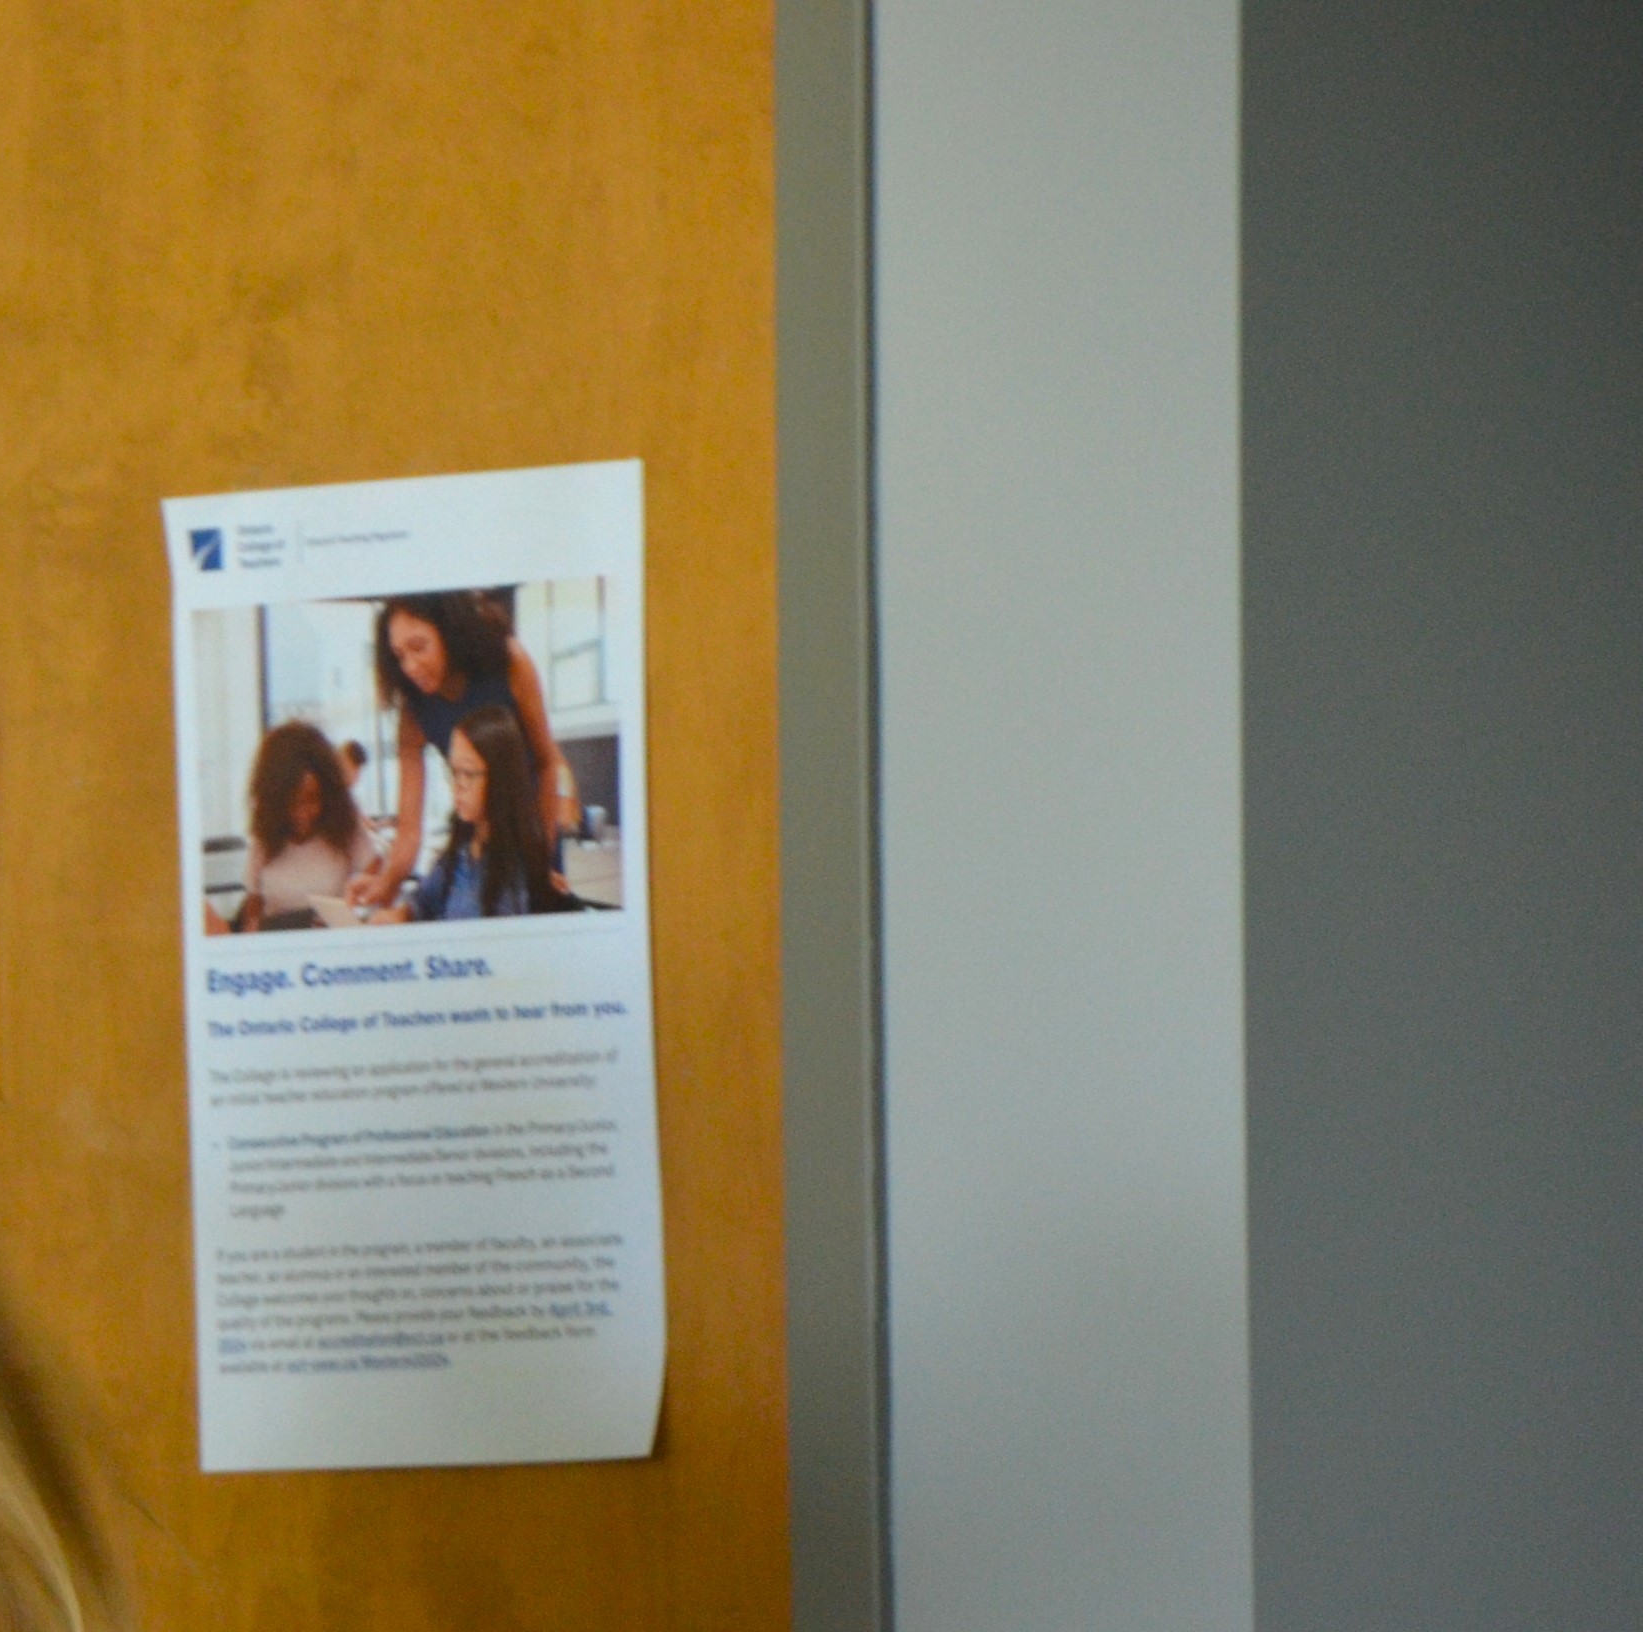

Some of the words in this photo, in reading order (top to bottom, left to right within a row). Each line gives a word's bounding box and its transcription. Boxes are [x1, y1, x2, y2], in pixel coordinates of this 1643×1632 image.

[206, 967, 293, 997] Engage.
[300, 959, 418, 987] Comment.
[424, 955, 492, 980] Share.
[207, 1019, 233, 1037] The
[299, 1013, 357, 1035] College
[362, 1010, 378, 1029] of
[513, 1003, 547, 1019] hear
[549, 1000, 587, 1018] from
